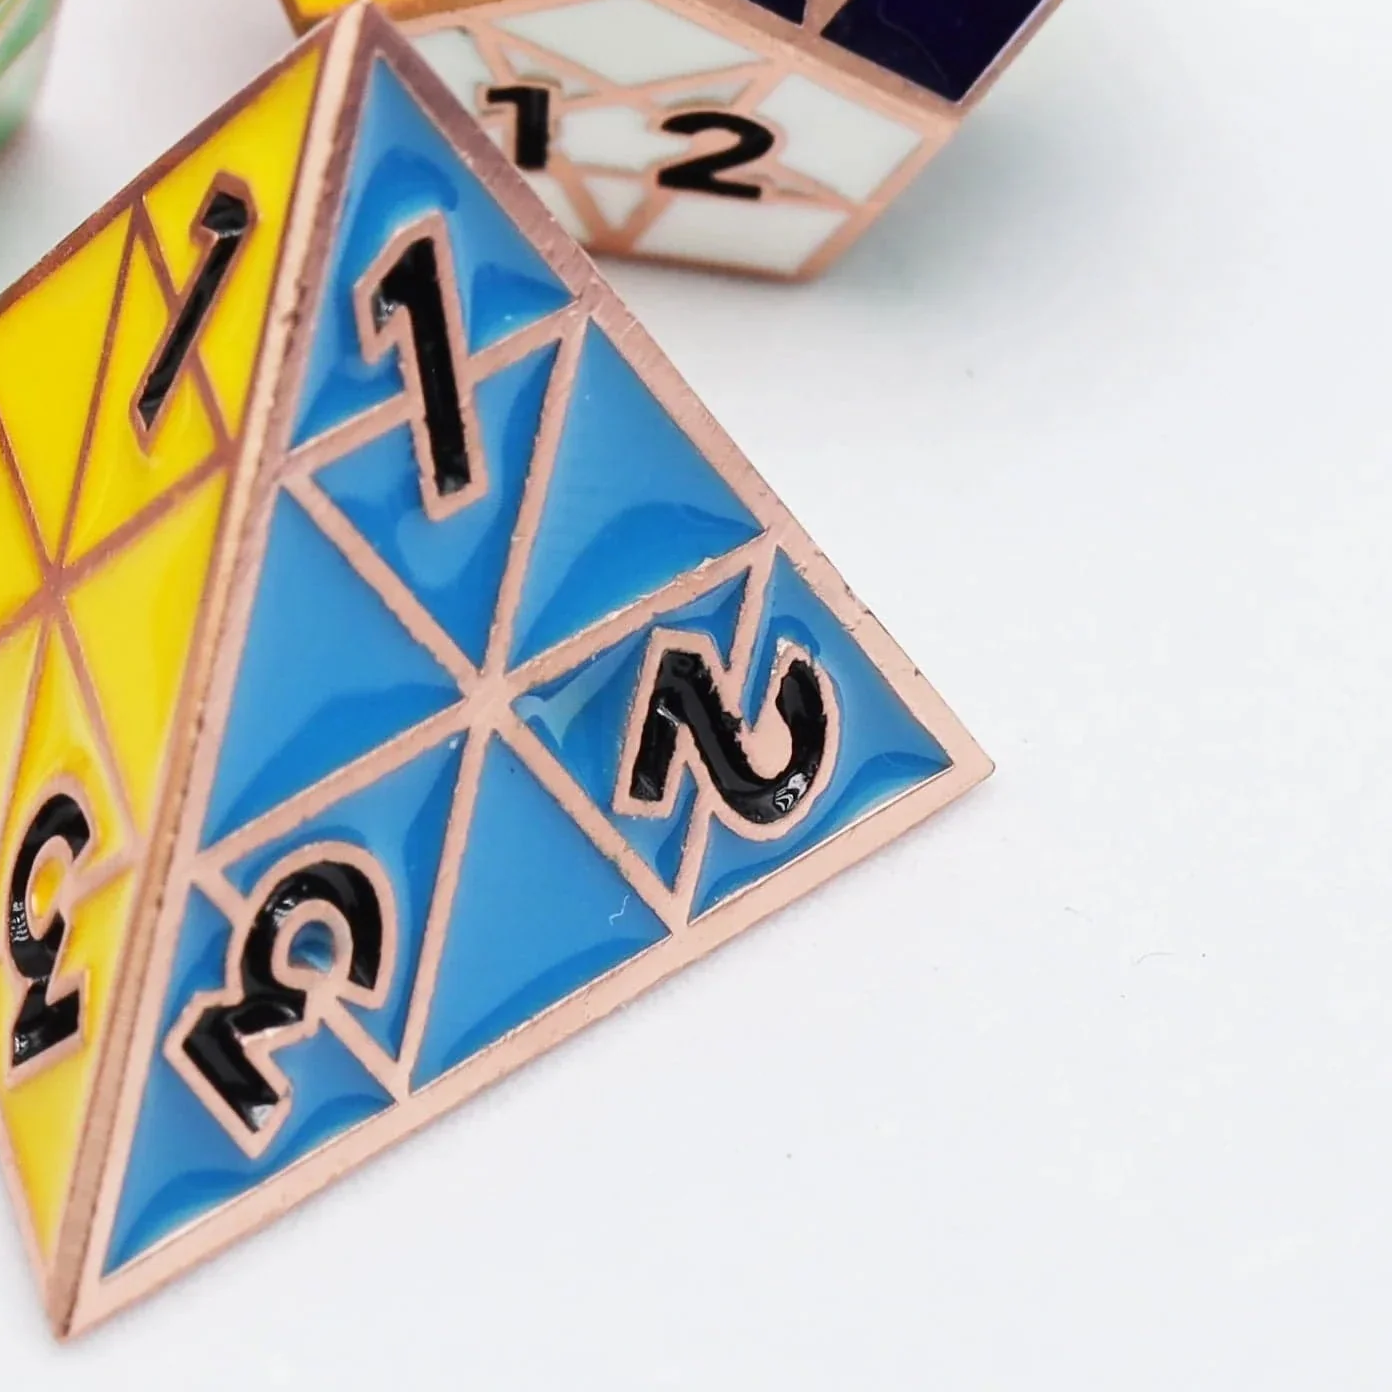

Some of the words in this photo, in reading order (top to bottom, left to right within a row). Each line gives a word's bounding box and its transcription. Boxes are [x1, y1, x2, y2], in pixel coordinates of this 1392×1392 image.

[486, 86, 778, 200] 12
[134, 188, 251, 436] 1
[366, 234, 472, 500] 1
[626, 646, 844, 828] 2
[8, 786, 98, 1070] 3
[183, 858, 384, 1136] 3
